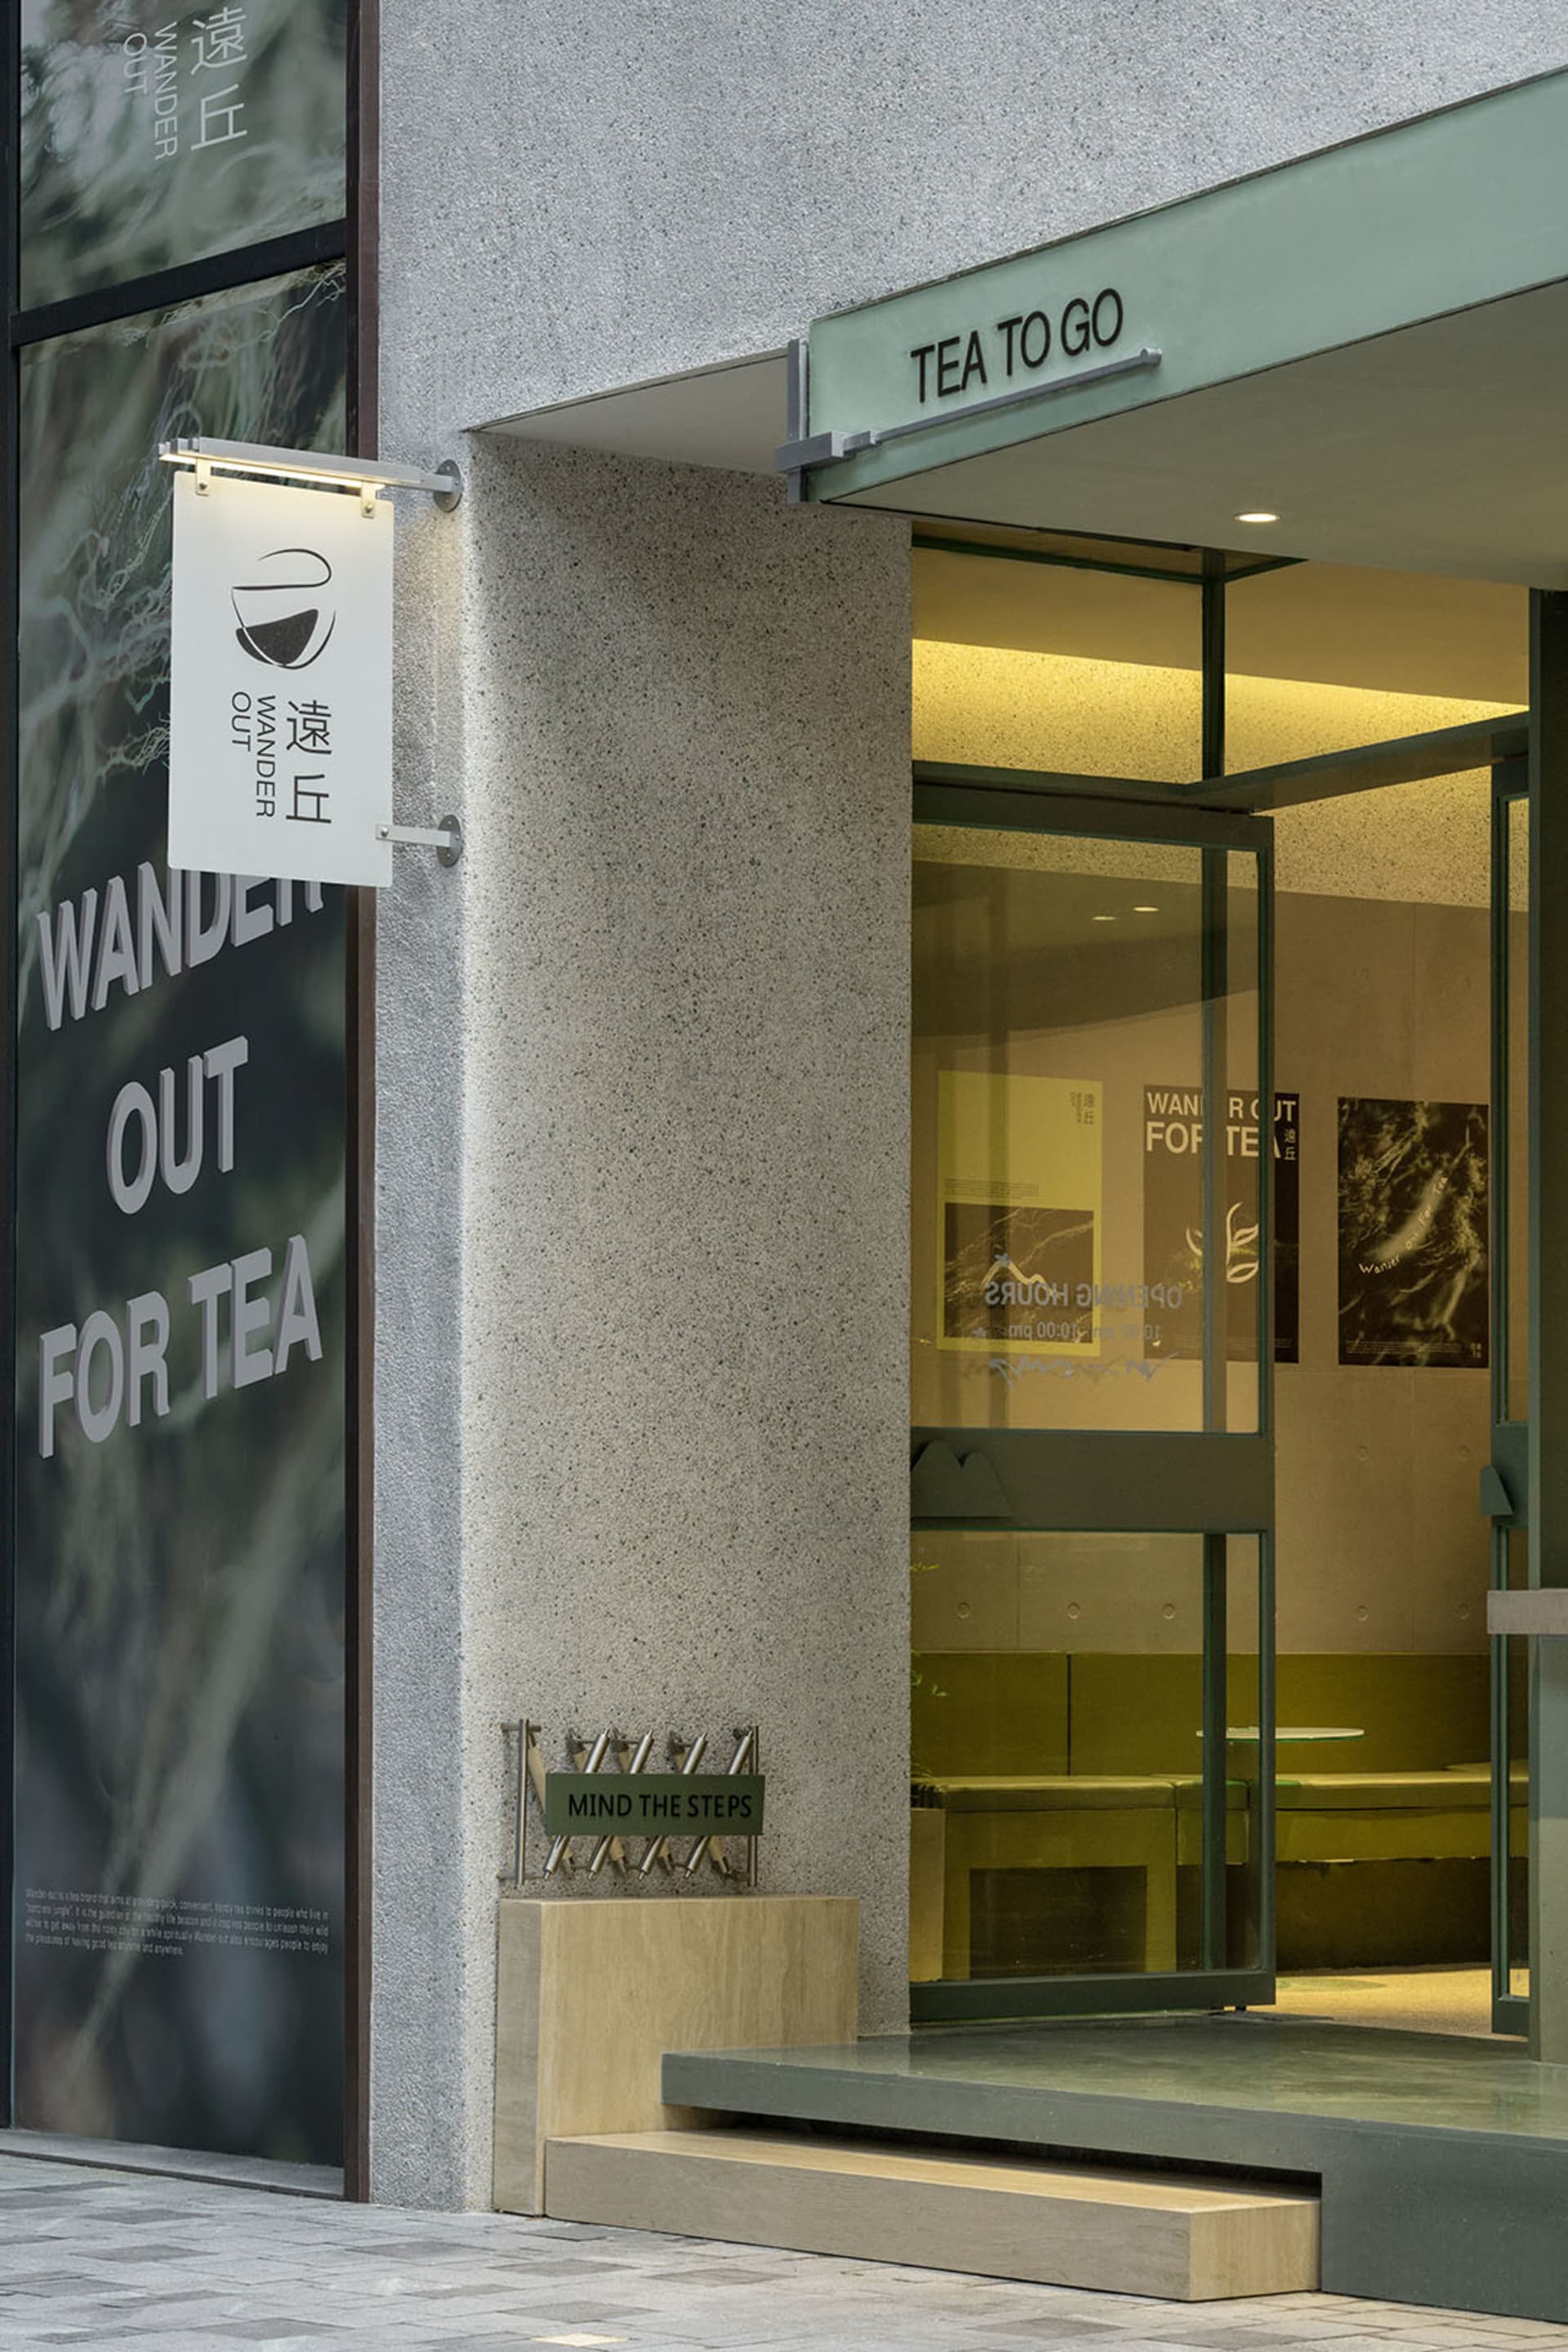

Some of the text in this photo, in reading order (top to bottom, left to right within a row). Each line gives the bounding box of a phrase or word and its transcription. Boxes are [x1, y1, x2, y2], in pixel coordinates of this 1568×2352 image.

[124, 33, 148, 95] OUT
[154, 21, 177, 160] WANDER
[191, 7, 247, 150] 遠丘
[910, 288, 1123, 403] TEA TO GO
[232, 692, 252, 752] OUT
[256, 696, 276, 817] WANDER
[287, 700, 332, 823] 遠丘
[107, 1035, 248, 1214] OUT
[39, 1235, 323, 1459] FOR TEA
[568, 1793, 752, 1818] MIND THE STEPS
